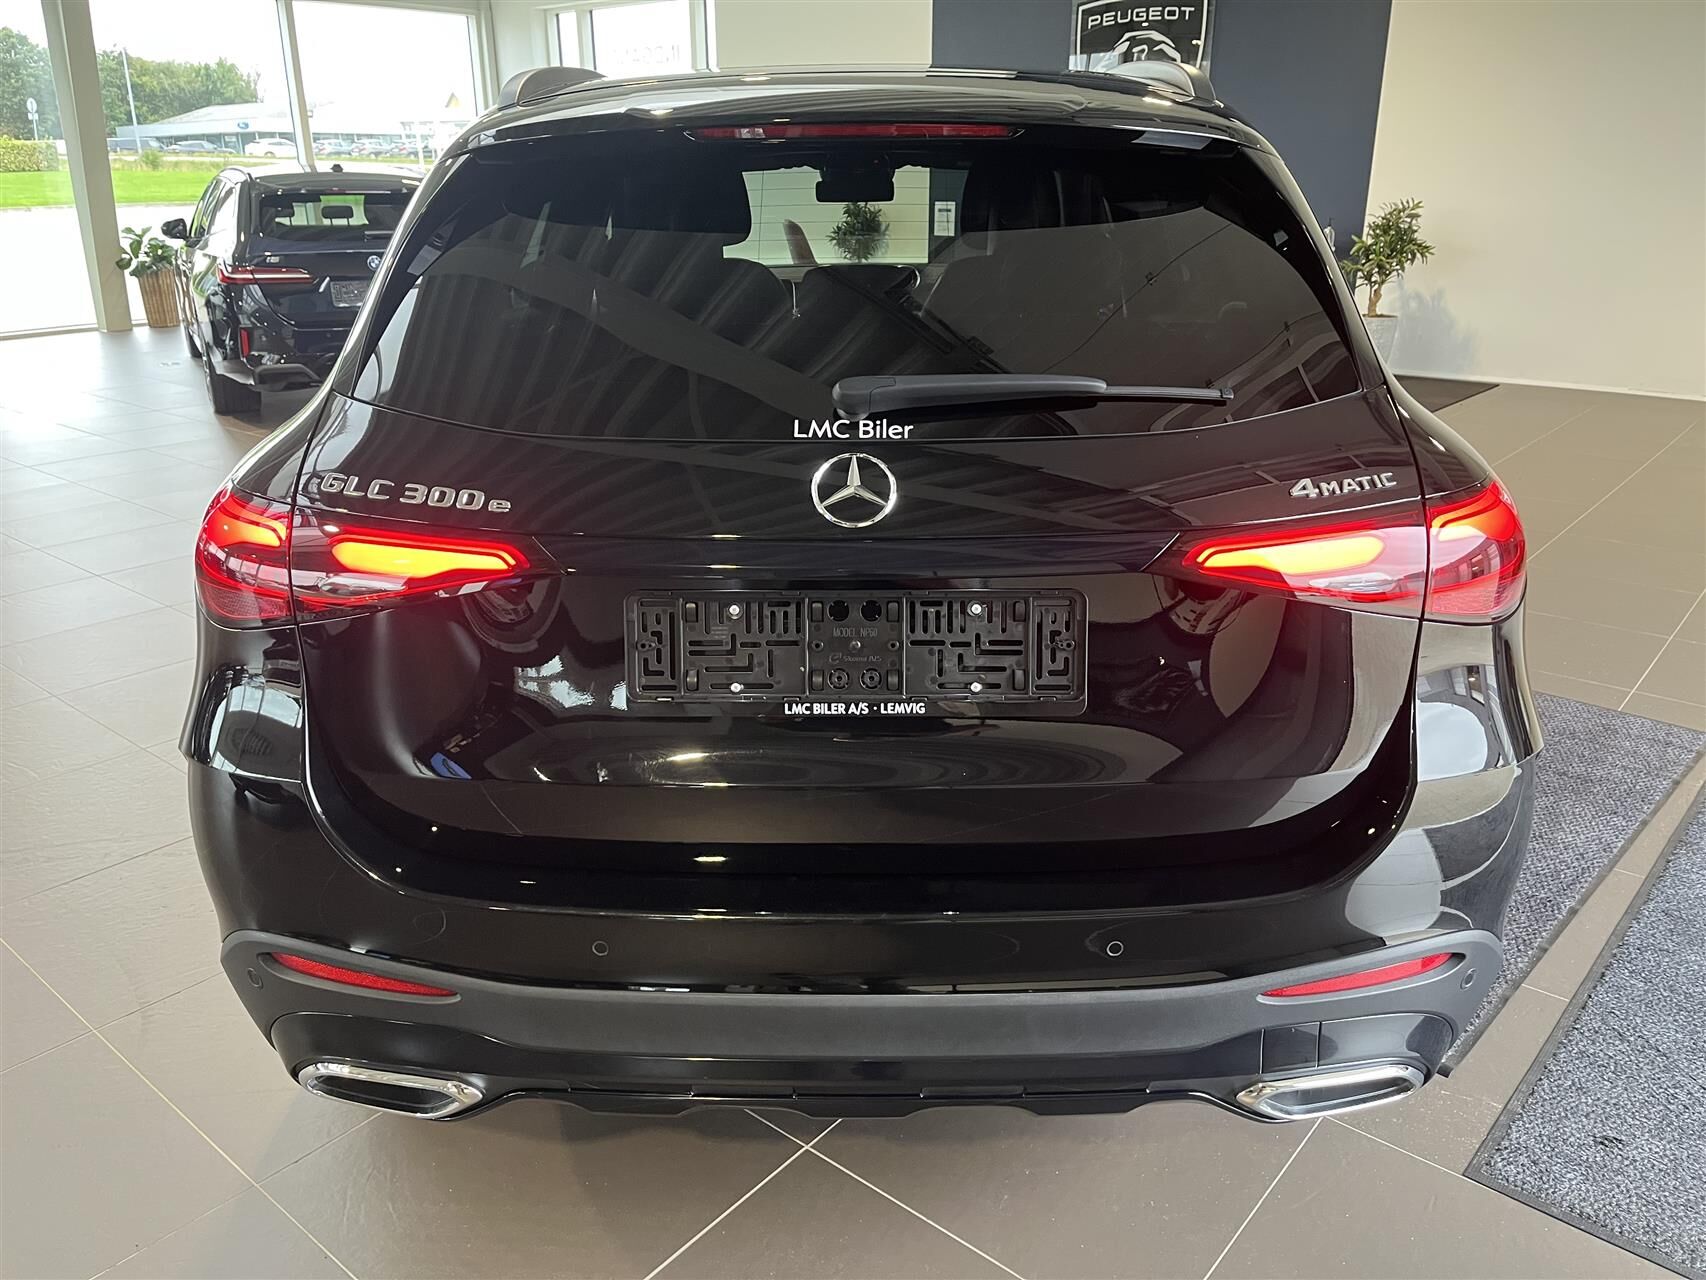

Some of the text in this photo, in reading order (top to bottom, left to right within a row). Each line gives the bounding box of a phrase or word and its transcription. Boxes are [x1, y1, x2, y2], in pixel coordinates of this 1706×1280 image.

[1087, 6, 1196, 29] PEUGEOT
[793, 418, 914, 439] LMC Biler
[320, 472, 395, 500] GLC
[1289, 472, 1398, 499] 4MATIC
[833, 627, 859, 638] MODEL
[784, 701, 926, 716] LMC BILER A/S LEMVIG
